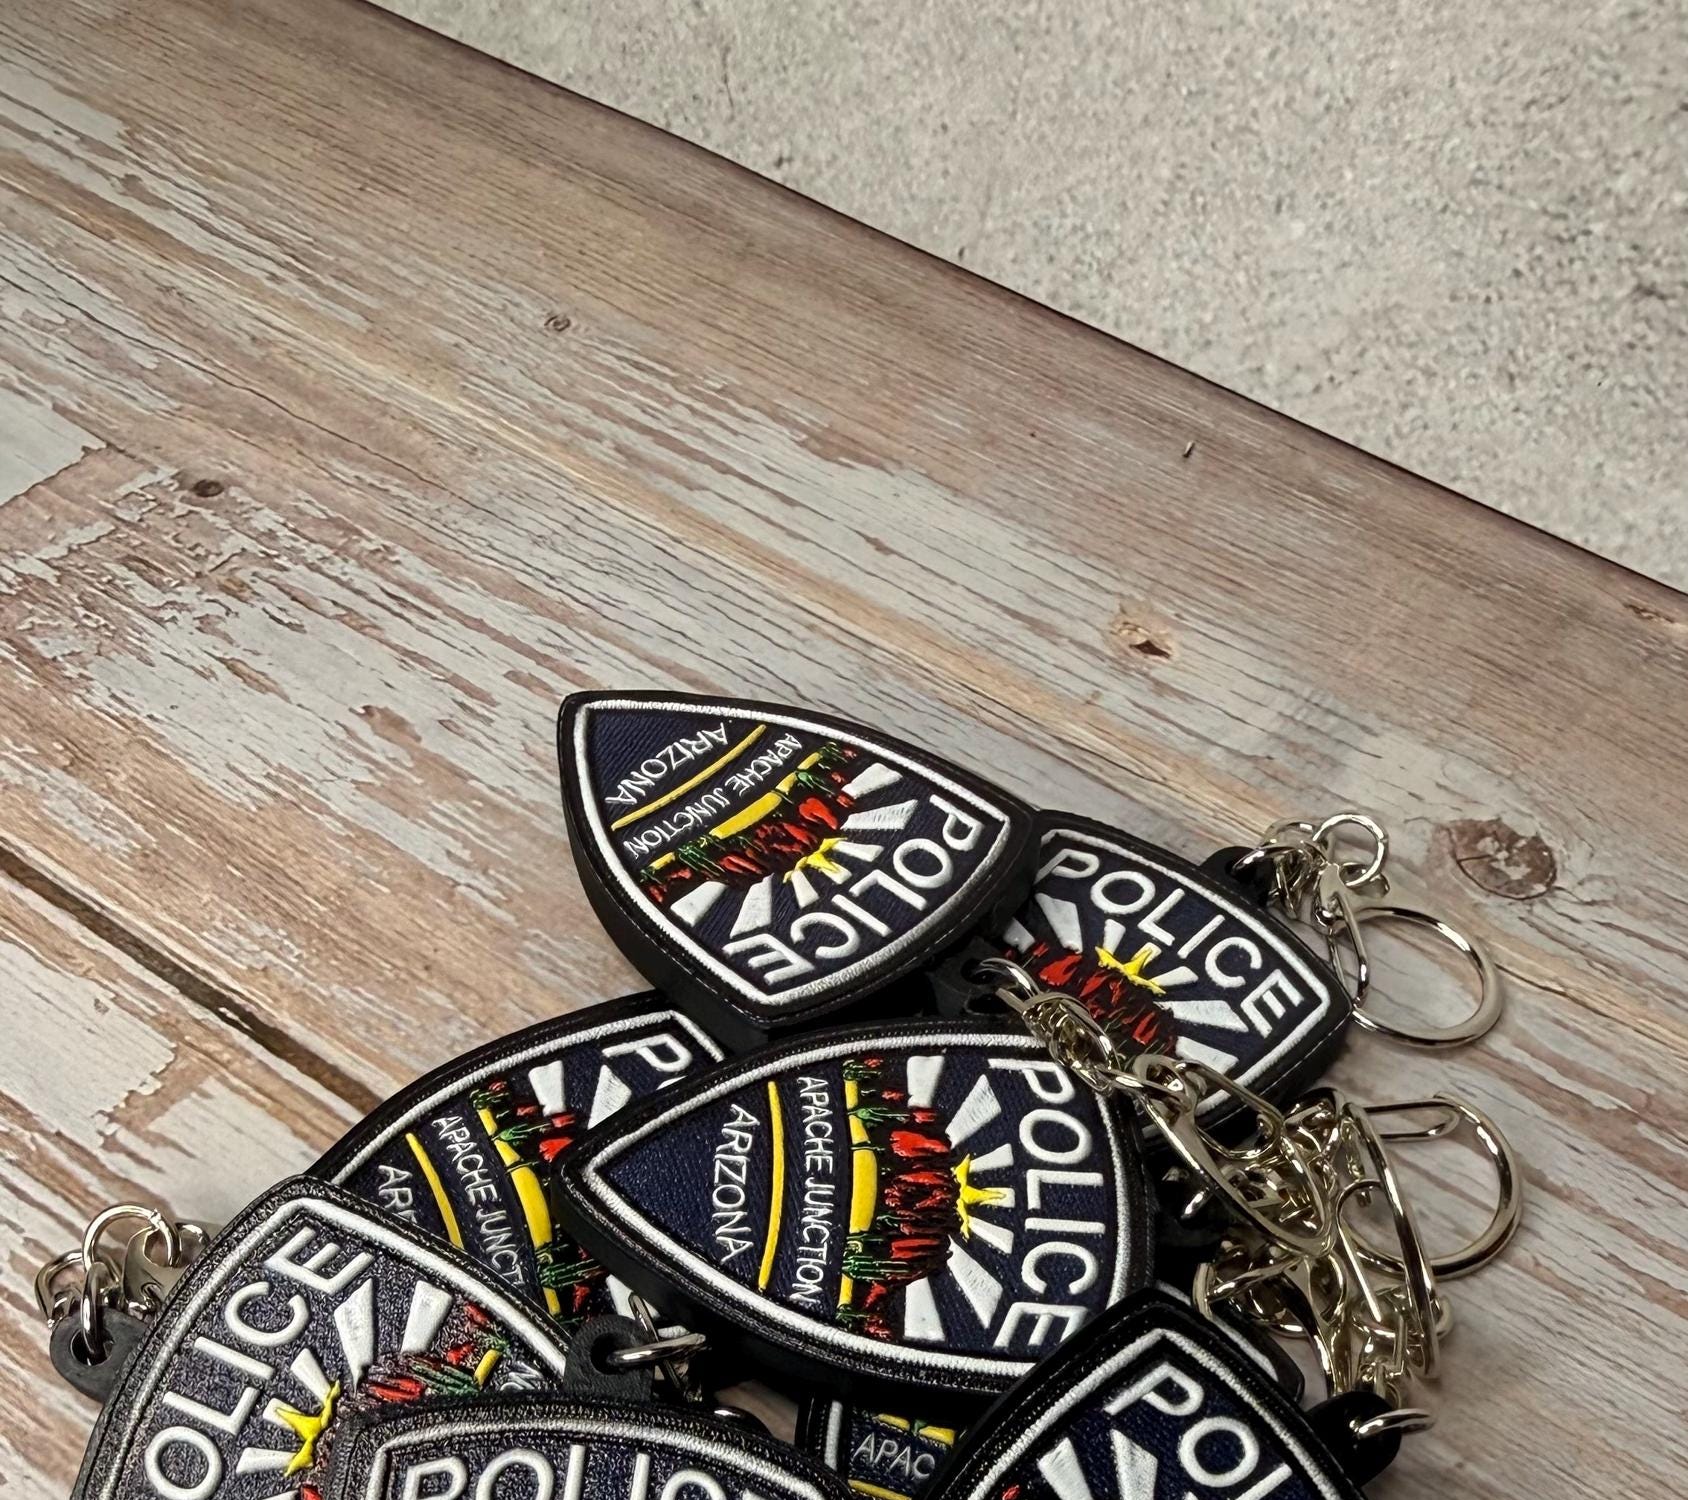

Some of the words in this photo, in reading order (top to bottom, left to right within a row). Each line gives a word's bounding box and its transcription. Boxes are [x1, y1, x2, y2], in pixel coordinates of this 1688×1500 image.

[604, 722, 729, 806] ARIZONA
[622, 787, 732, 861] JUNCTION
[723, 732, 803, 798] APACHE
[722, 794, 986, 986] POLICE
[1033, 848, 1306, 1038] POLICE
[711, 1102, 760, 1263] ARIZONA
[796, 1075, 835, 1175] APACHE
[431, 1115, 498, 1206] APACHE
[475, 1208, 525, 1286] JUNCT
[790, 1175, 838, 1305] JUNCTION
[988, 1058, 1106, 1350] POLICE
[851, 1432, 937, 1480] APAC
